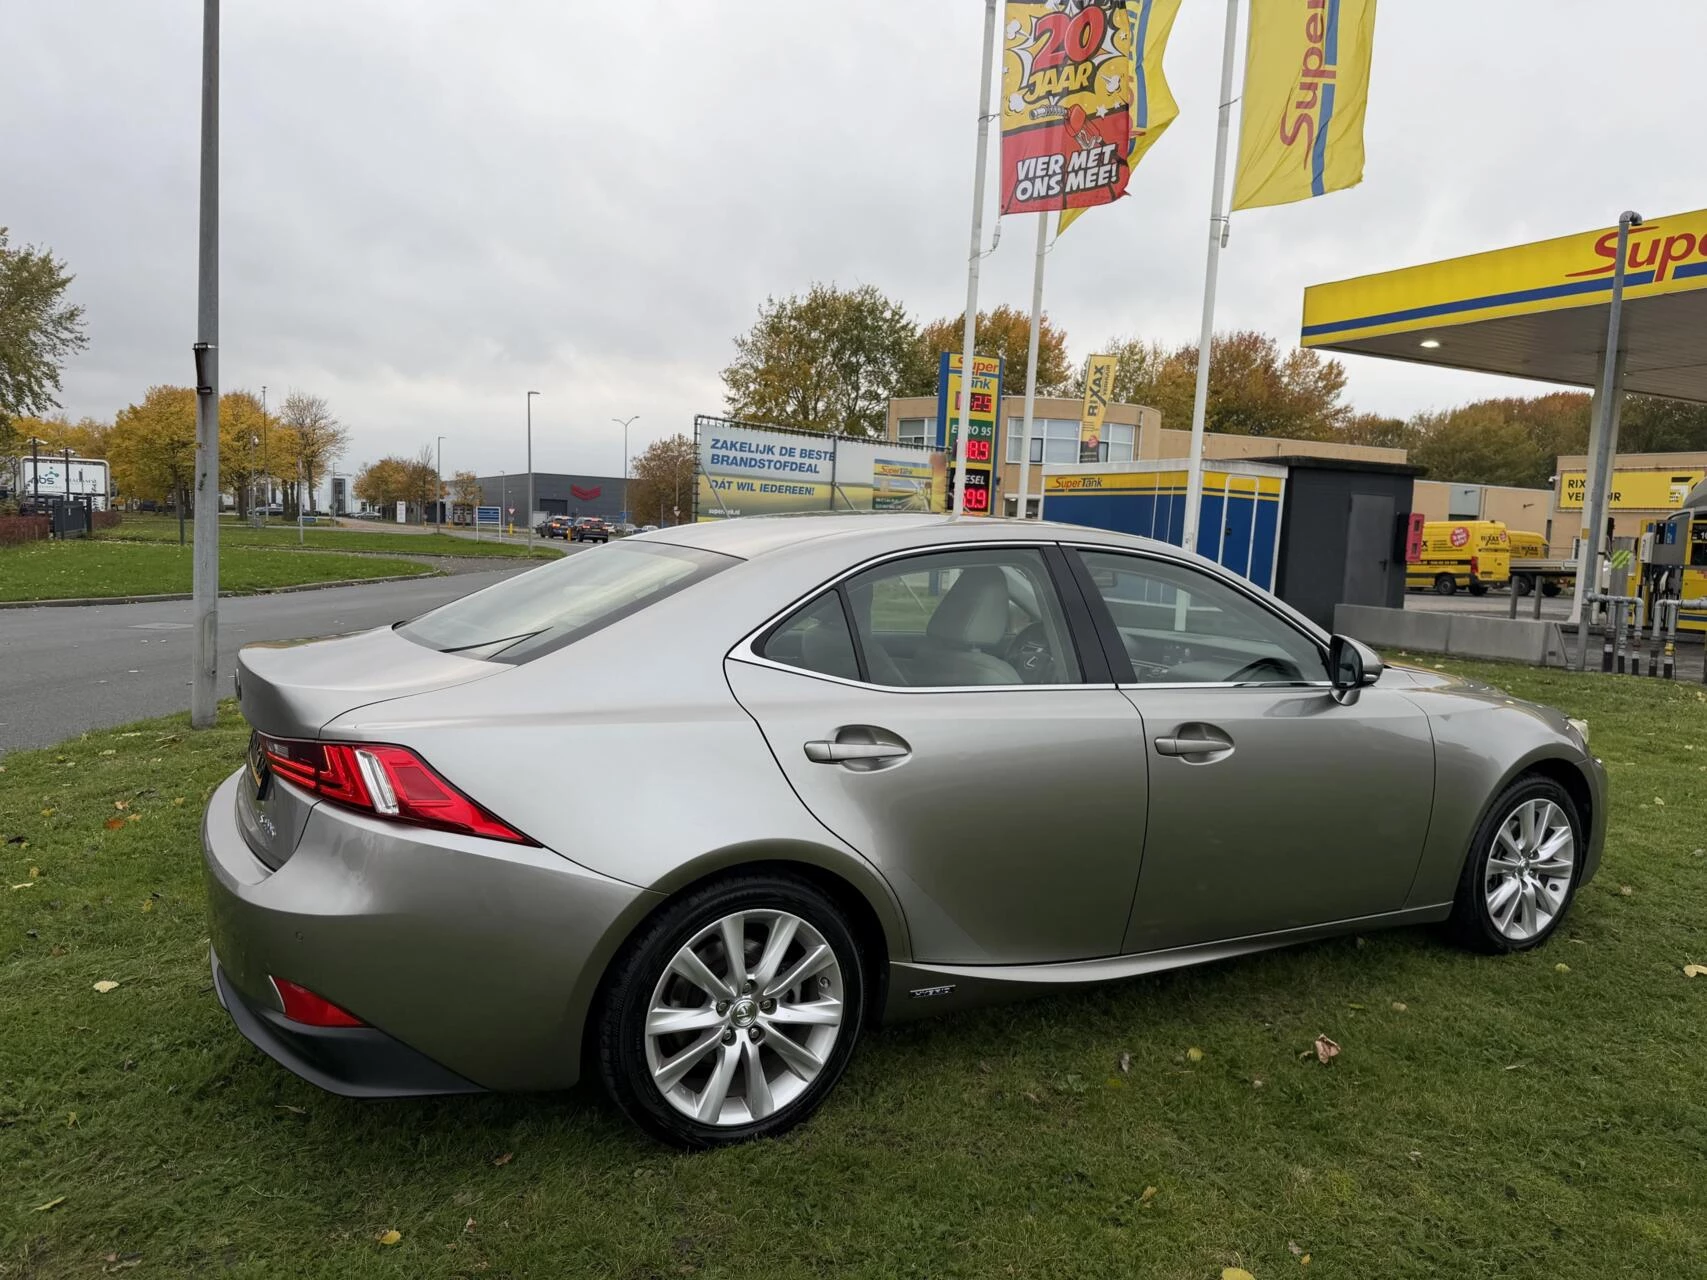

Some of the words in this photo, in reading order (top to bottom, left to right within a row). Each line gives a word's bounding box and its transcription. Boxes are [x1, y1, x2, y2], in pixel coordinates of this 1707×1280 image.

[1032, 6, 1104, 71] 20
[1023, 61, 1093, 98] JAAR
[1017, 154, 1065, 181] VIER
[1068, 143, 1116, 172] MET
[1015, 174, 1062, 201] ONS
[1065, 163, 1117, 192] MEE!
[1087, 364, 1106, 417] RIXAX
[710, 438, 776, 456] ZAKELIJK
[779, 446, 797, 462] DE
[799, 448, 836, 462] BESTE
[981, 427, 992, 436] 95
[710, 453, 820, 474] BRANDSTOFDEAL
[736, 481, 757, 492] WIL
[760, 483, 816, 497] IEDEREEN!
